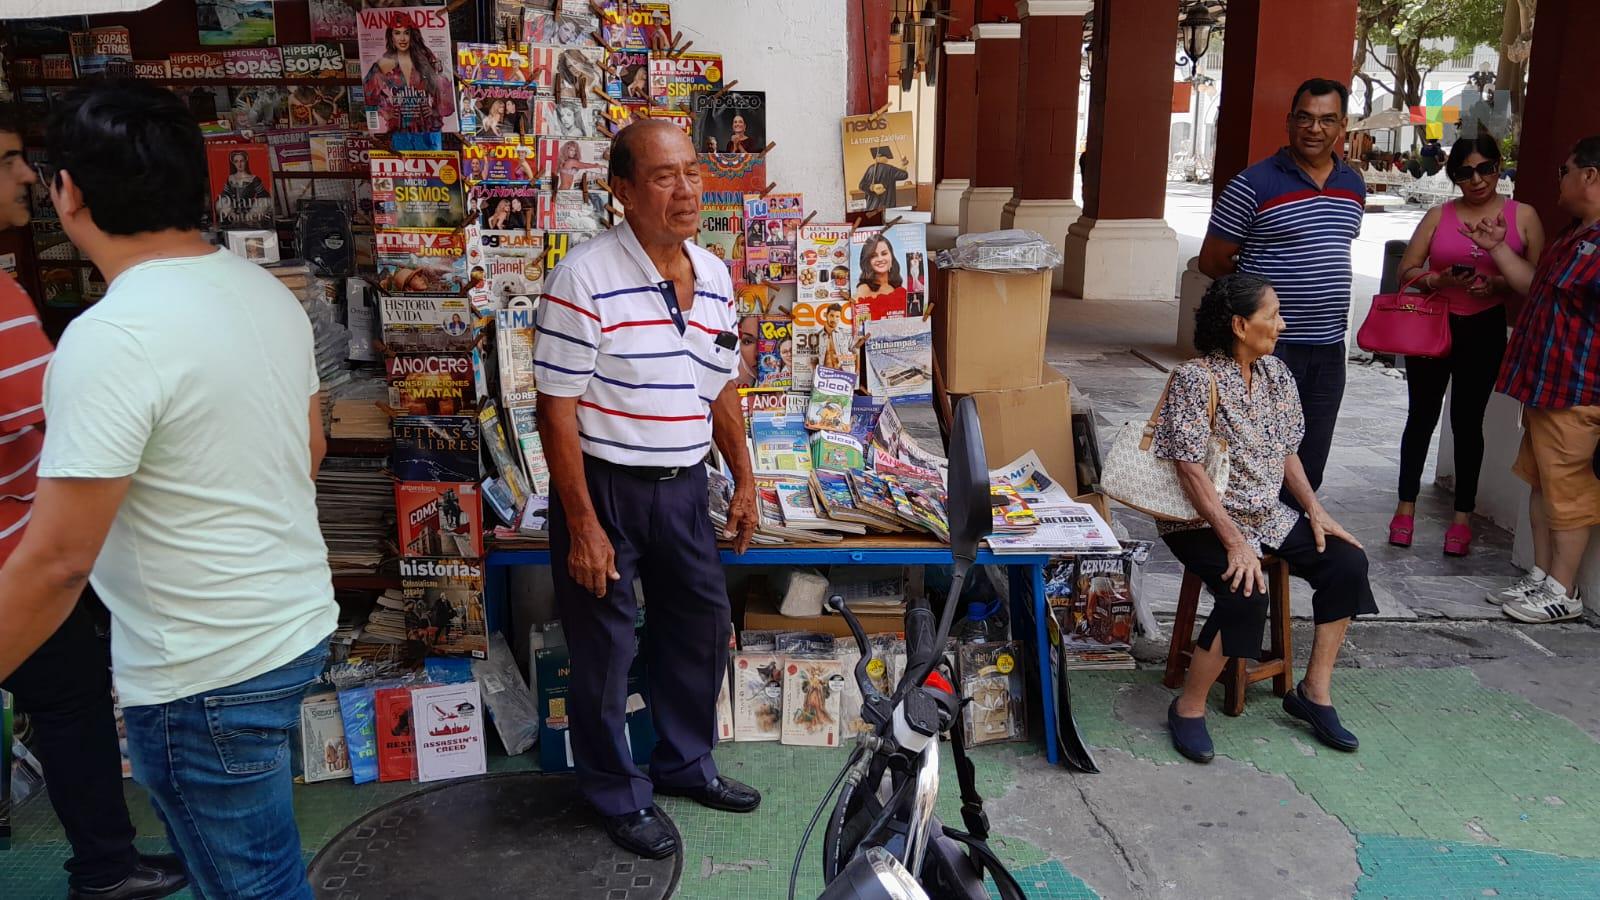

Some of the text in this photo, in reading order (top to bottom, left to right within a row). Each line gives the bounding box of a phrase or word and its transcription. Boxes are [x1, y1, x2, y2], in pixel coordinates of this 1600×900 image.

[97, 33, 128, 44] SOPAS
[97, 44, 129, 54] LETRAS
[283, 46, 315, 55] HIPER
[170, 55, 201, 65] HIPER
[285, 57, 344, 72] SOPAS
[134, 64, 164, 75] SOPAS
[172, 64, 226, 78] SOPAS
[225, 60, 283, 74] SOPAS
[533, 48, 553, 86] H
[845, 118, 887, 132] nexos
[539, 139, 560, 176] H
[371, 159, 448, 177] muy
[395, 187, 450, 202] SISMOS
[537, 195, 558, 229] H
[376, 233, 438, 248] muy
[800, 228, 849, 240] Cocina
[418, 246, 464, 257] JUNIOR
[385, 299, 437, 311] HISTORIA
[396, 311, 423, 321] VIDA
[796, 333, 820, 348] 30
[871, 340, 917, 351] chinampas
[393, 380, 470, 388] CONSPIRACIONES
[817, 380, 849, 392] picot
[412, 388, 463, 399] MATAN
[393, 426, 461, 439] LETRAS
[418, 438, 480, 451] LIBRES
[410, 499, 439, 525] CDMX
[400, 560, 480, 577] historias
[423, 736, 478, 749] ASSASSIN'S
[436, 744, 466, 753] CREED
